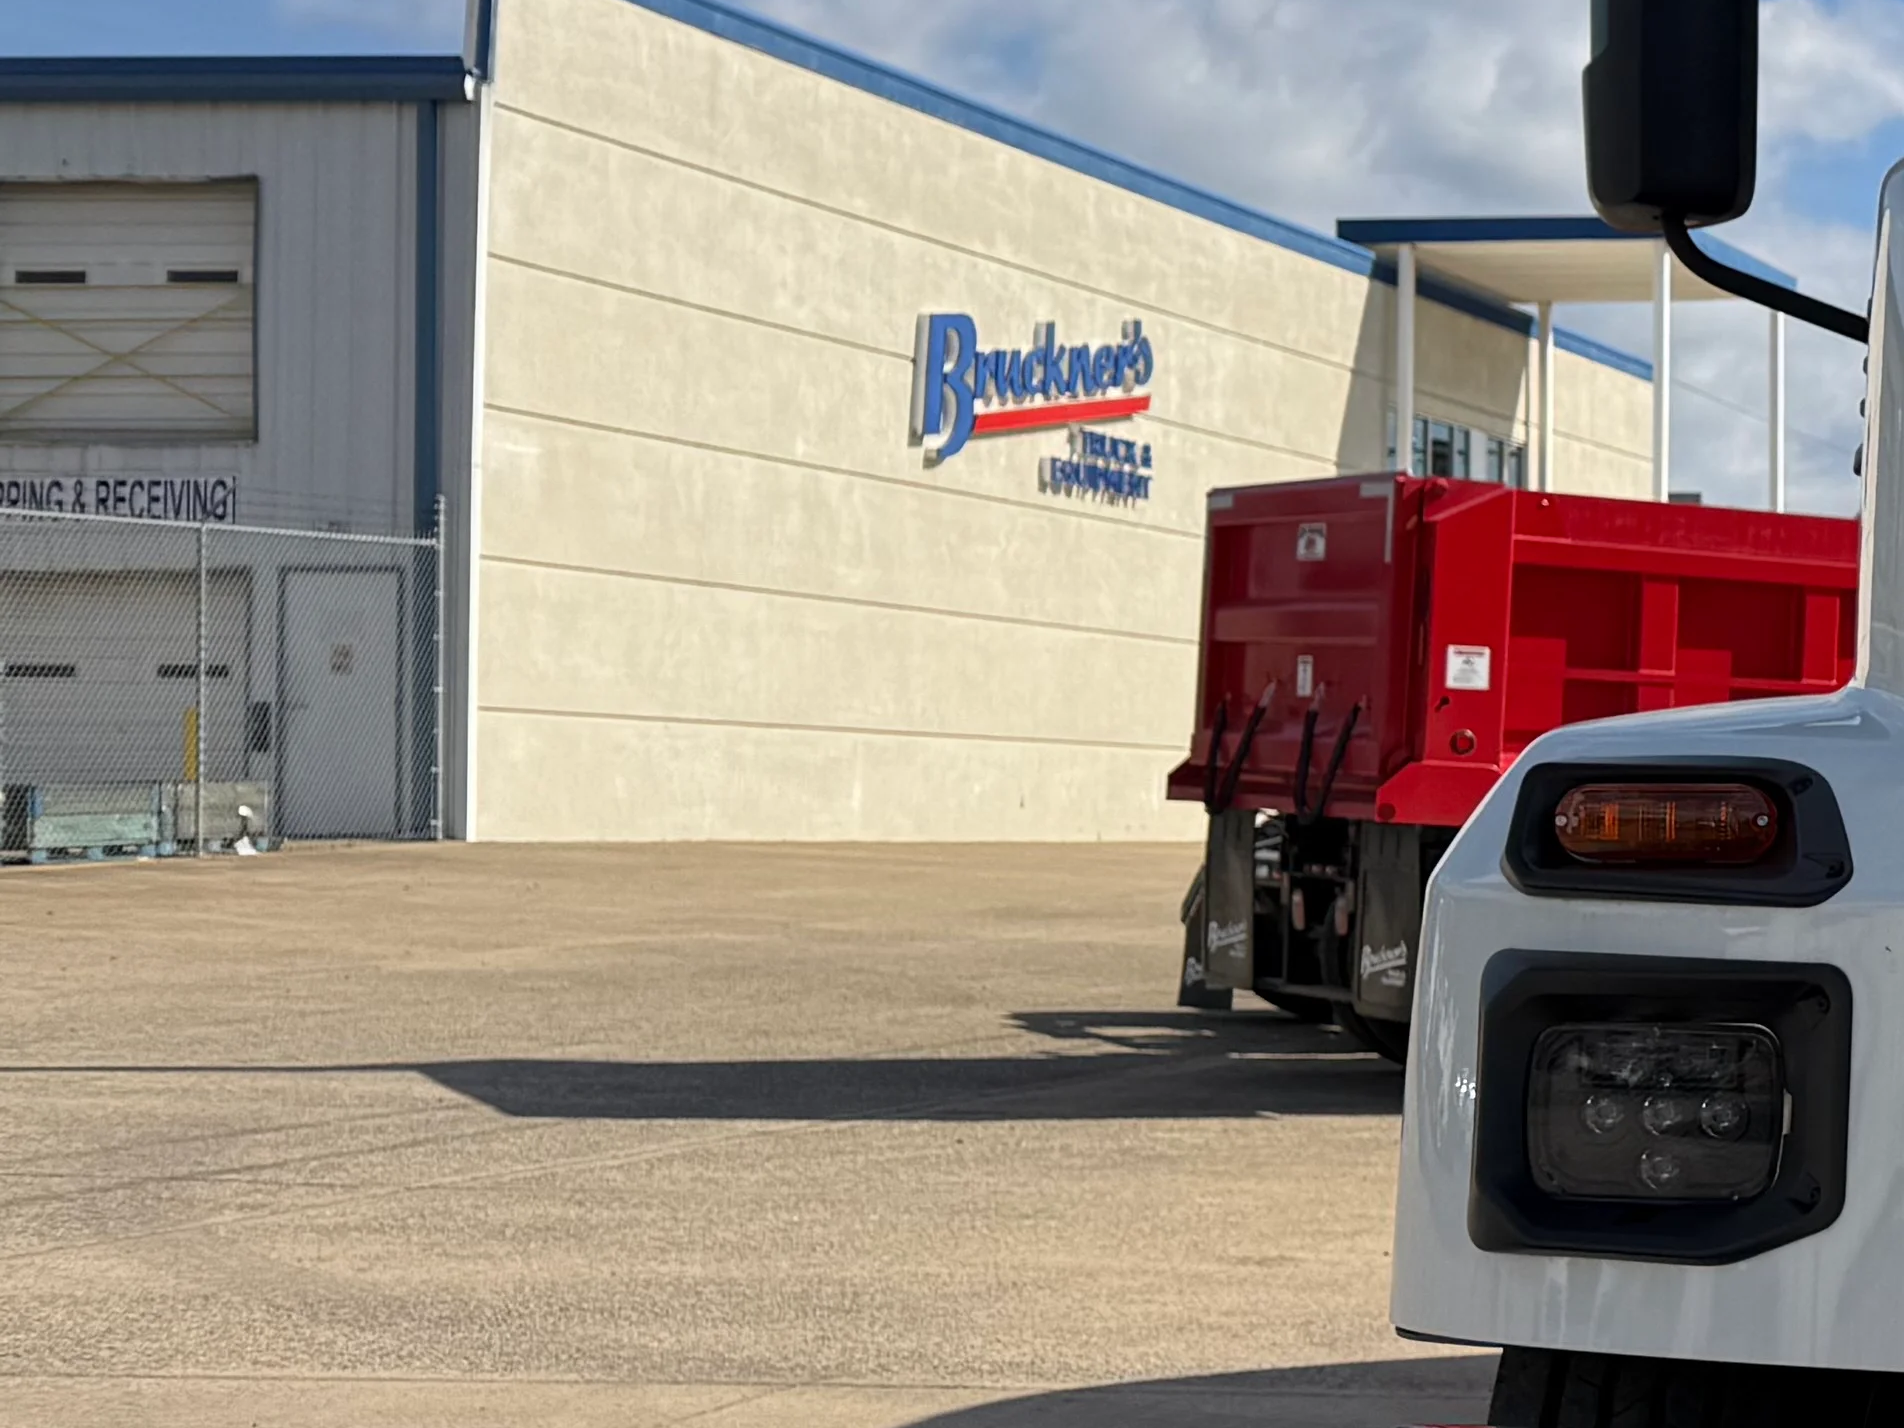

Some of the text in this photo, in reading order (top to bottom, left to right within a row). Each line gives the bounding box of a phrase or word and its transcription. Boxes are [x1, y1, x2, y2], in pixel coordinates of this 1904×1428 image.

[920, 313, 1154, 461] Bruckner's
[1079, 425, 1137, 465] TRUCK
[71, 479, 86, 514] &
[95, 479, 228, 521] RECEIVING
